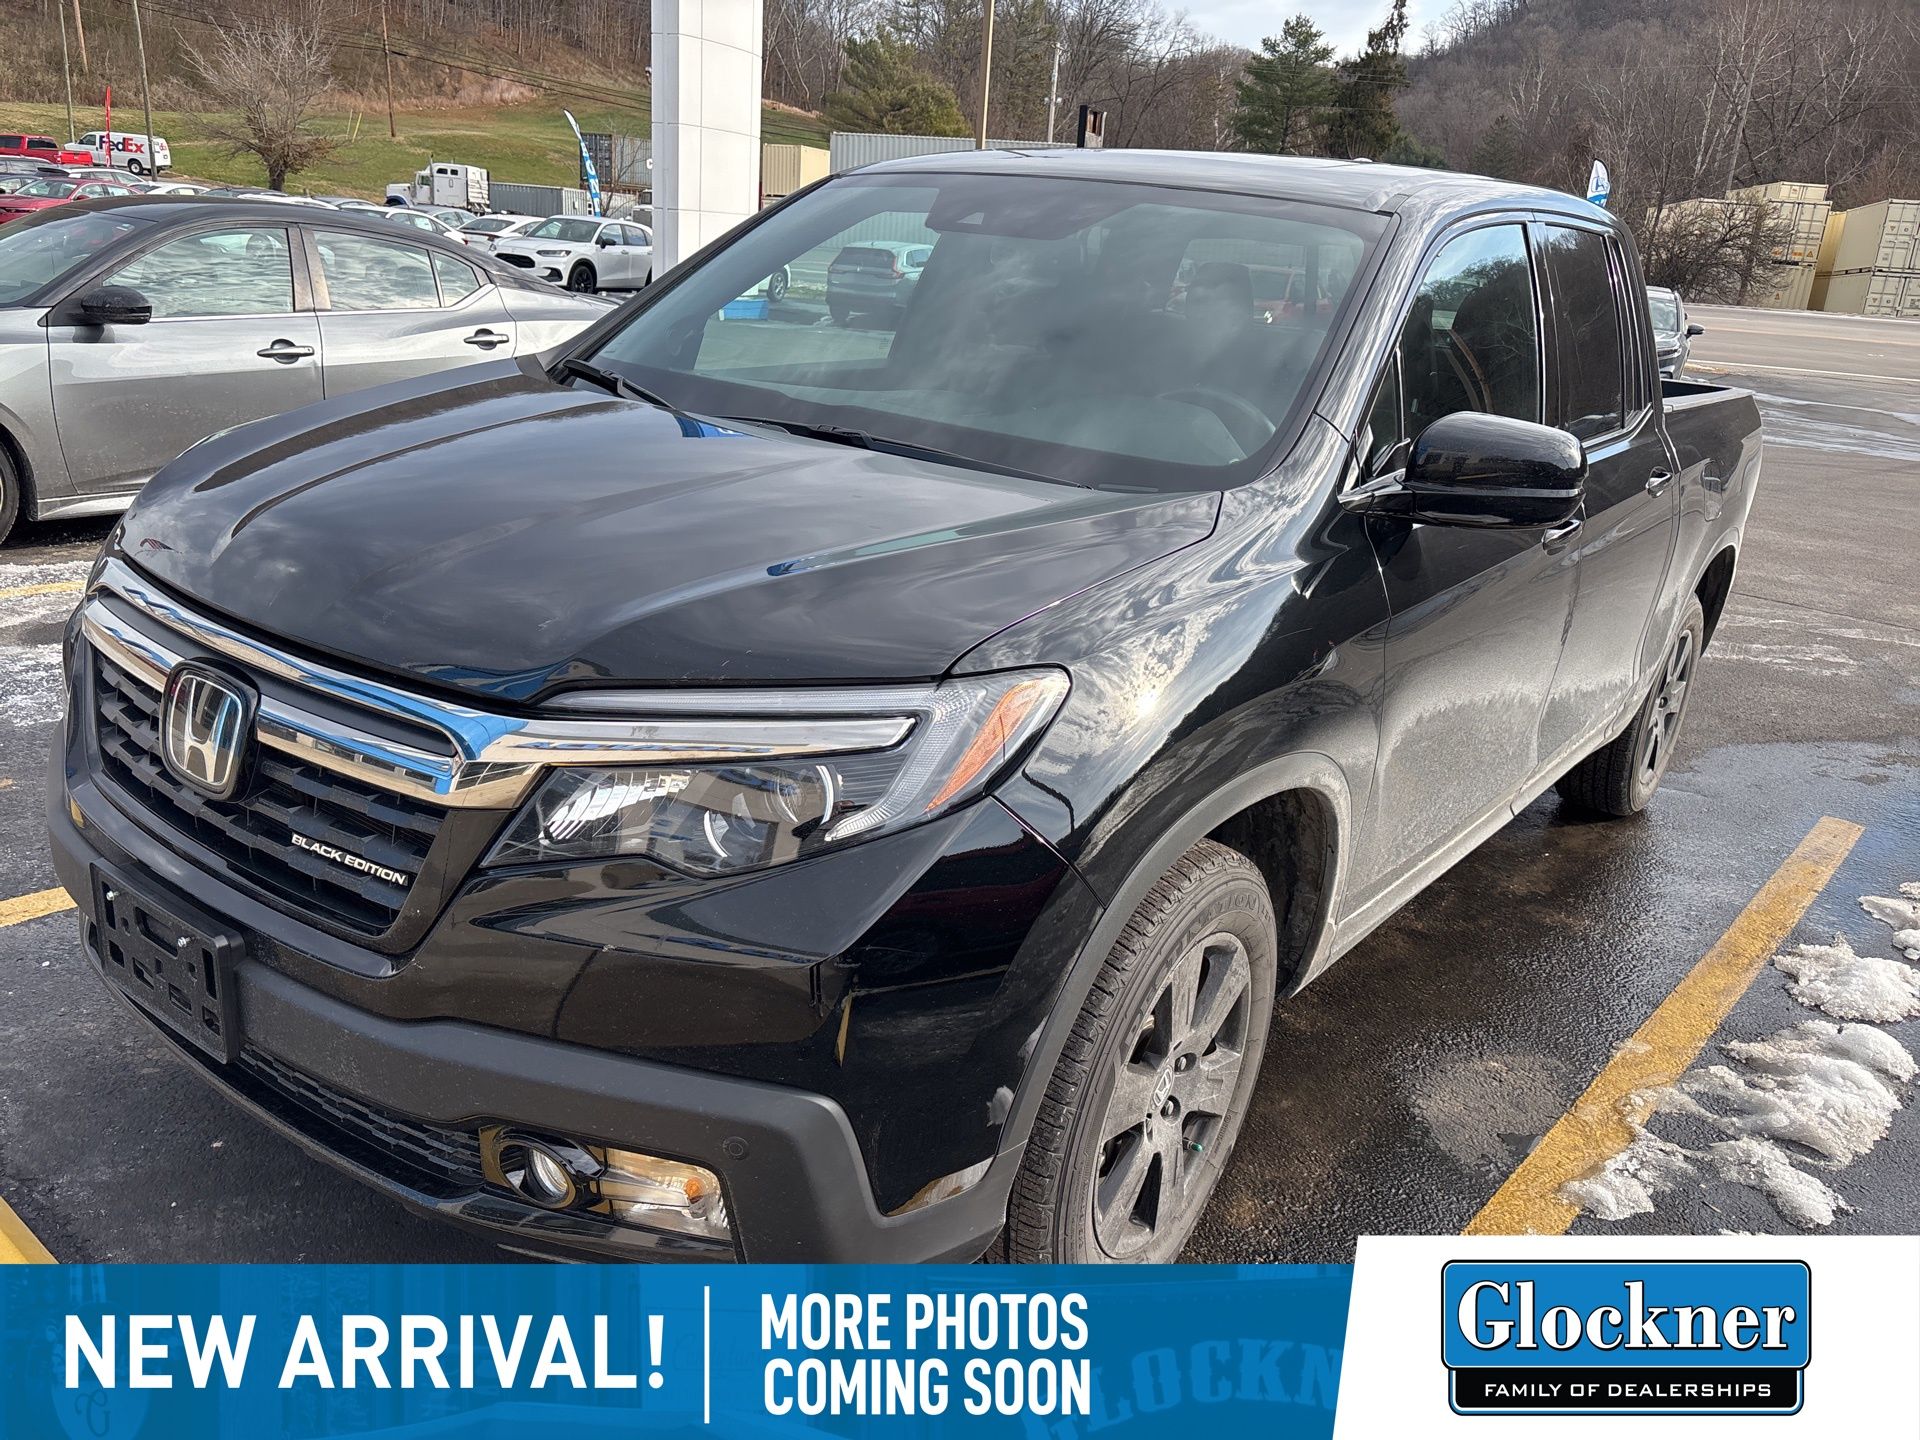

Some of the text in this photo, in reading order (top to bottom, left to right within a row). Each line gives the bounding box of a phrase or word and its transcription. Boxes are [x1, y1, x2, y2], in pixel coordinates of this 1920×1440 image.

[99, 135, 145, 154] FedEx
[291, 833, 406, 885] BLACK EDITION
